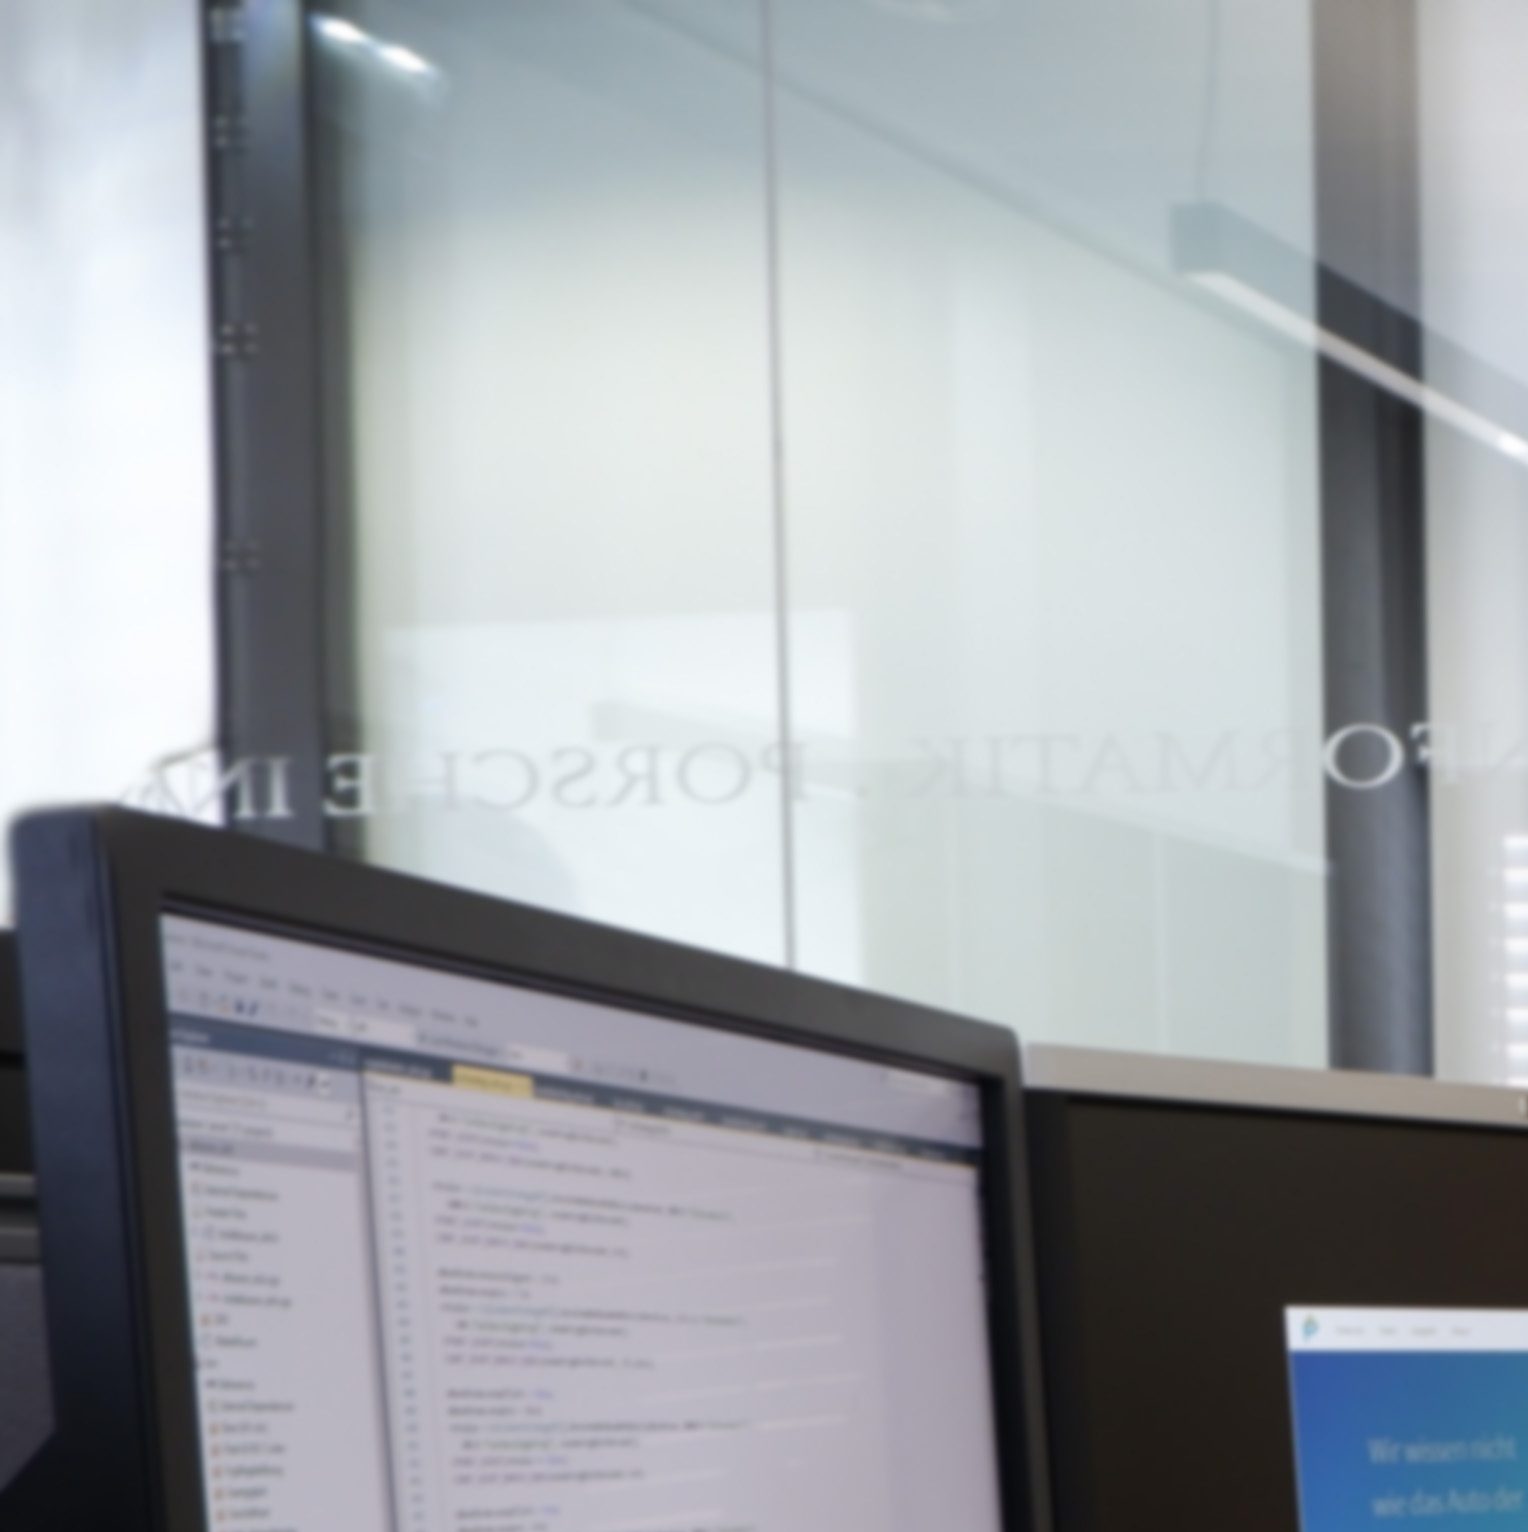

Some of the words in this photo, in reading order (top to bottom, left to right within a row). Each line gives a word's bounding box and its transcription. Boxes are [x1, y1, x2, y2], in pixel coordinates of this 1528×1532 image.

[1368, 1438, 1399, 1463] Wir
[1406, 1436, 1468, 1462] wissen
[1375, 1491, 1405, 1516] wie
[1412, 1488, 1442, 1515] das
[1448, 1488, 1489, 1513] Auto
[1496, 1485, 1523, 1511] der
